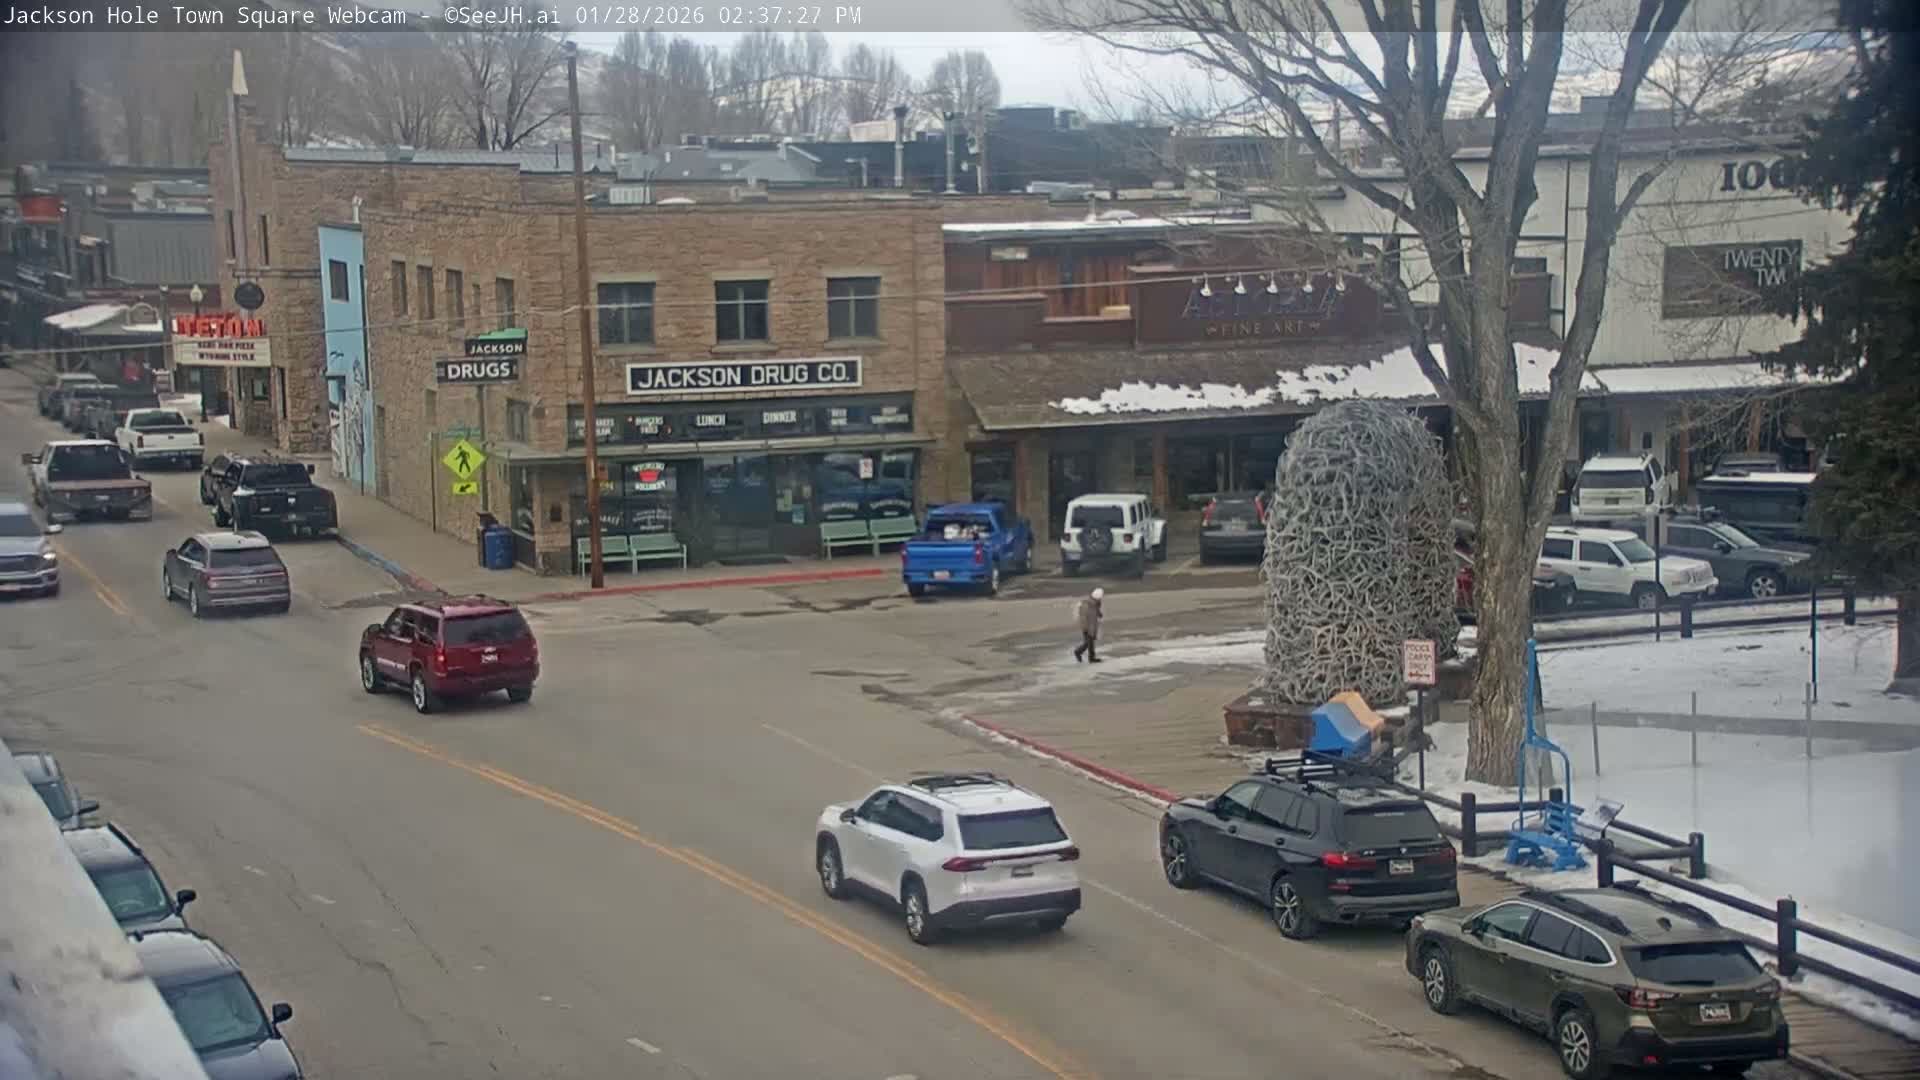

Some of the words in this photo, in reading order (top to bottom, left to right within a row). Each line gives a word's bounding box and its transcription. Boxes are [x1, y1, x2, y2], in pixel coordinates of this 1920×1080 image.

[1723, 246, 1798, 270] TWENTY
[1222, 320, 1262, 337] FINE
[1272, 319, 1304, 336] ART
[470, 343, 523, 354] JACKSON
[447, 362, 511, 379] DRUGS
[638, 365, 741, 389] JACKSON
[751, 364, 809, 385] DRUG
[817, 362, 851, 382] CO.
[696, 414, 726, 426] LUNCH
[763, 410, 797, 424] DINNER
